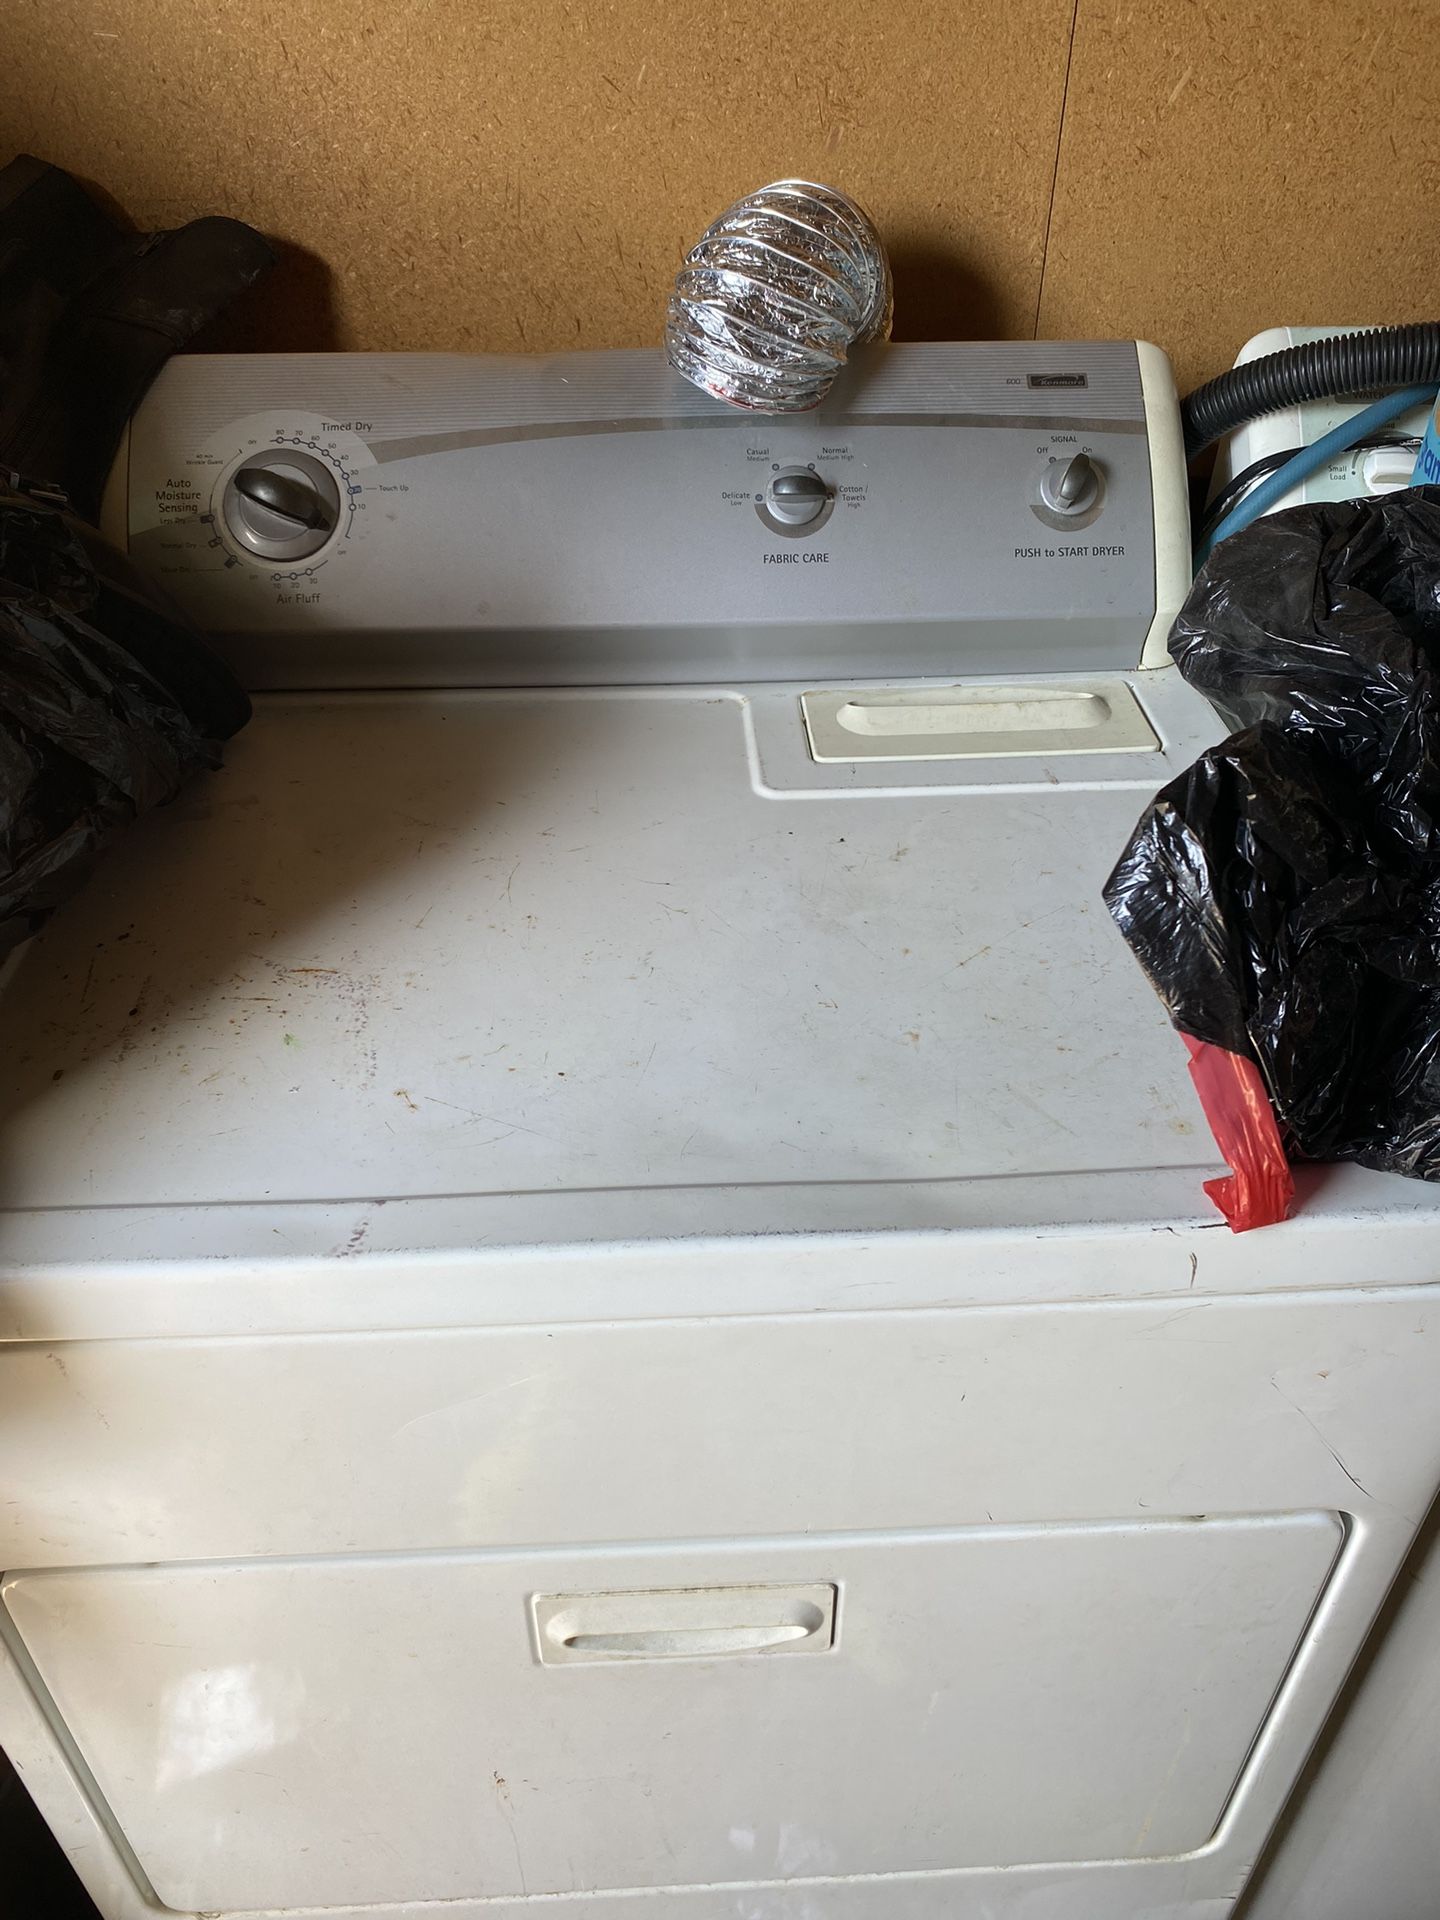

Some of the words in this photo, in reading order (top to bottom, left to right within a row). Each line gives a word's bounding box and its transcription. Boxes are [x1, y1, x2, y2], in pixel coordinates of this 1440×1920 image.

[321, 421, 351, 432] Timed
[355, 421, 373, 433] Dry
[1036, 446, 1048, 454] Off
[166, 479, 192, 488] Auto
[839, 485, 863, 493] Cotton
[155, 490, 201, 501] Moisture
[158, 503, 198, 515] Sensing
[1014, 548, 1041, 558] PUSH
[1045, 548, 1055, 557] to
[1058, 547, 1088, 557] START
[1092, 546, 1125, 556] DRYER
[763, 554, 799, 564] FABRIC
[802, 553, 829, 563] CARE
[276, 594, 293, 604] Air
[296, 593, 321, 603] Fluff
